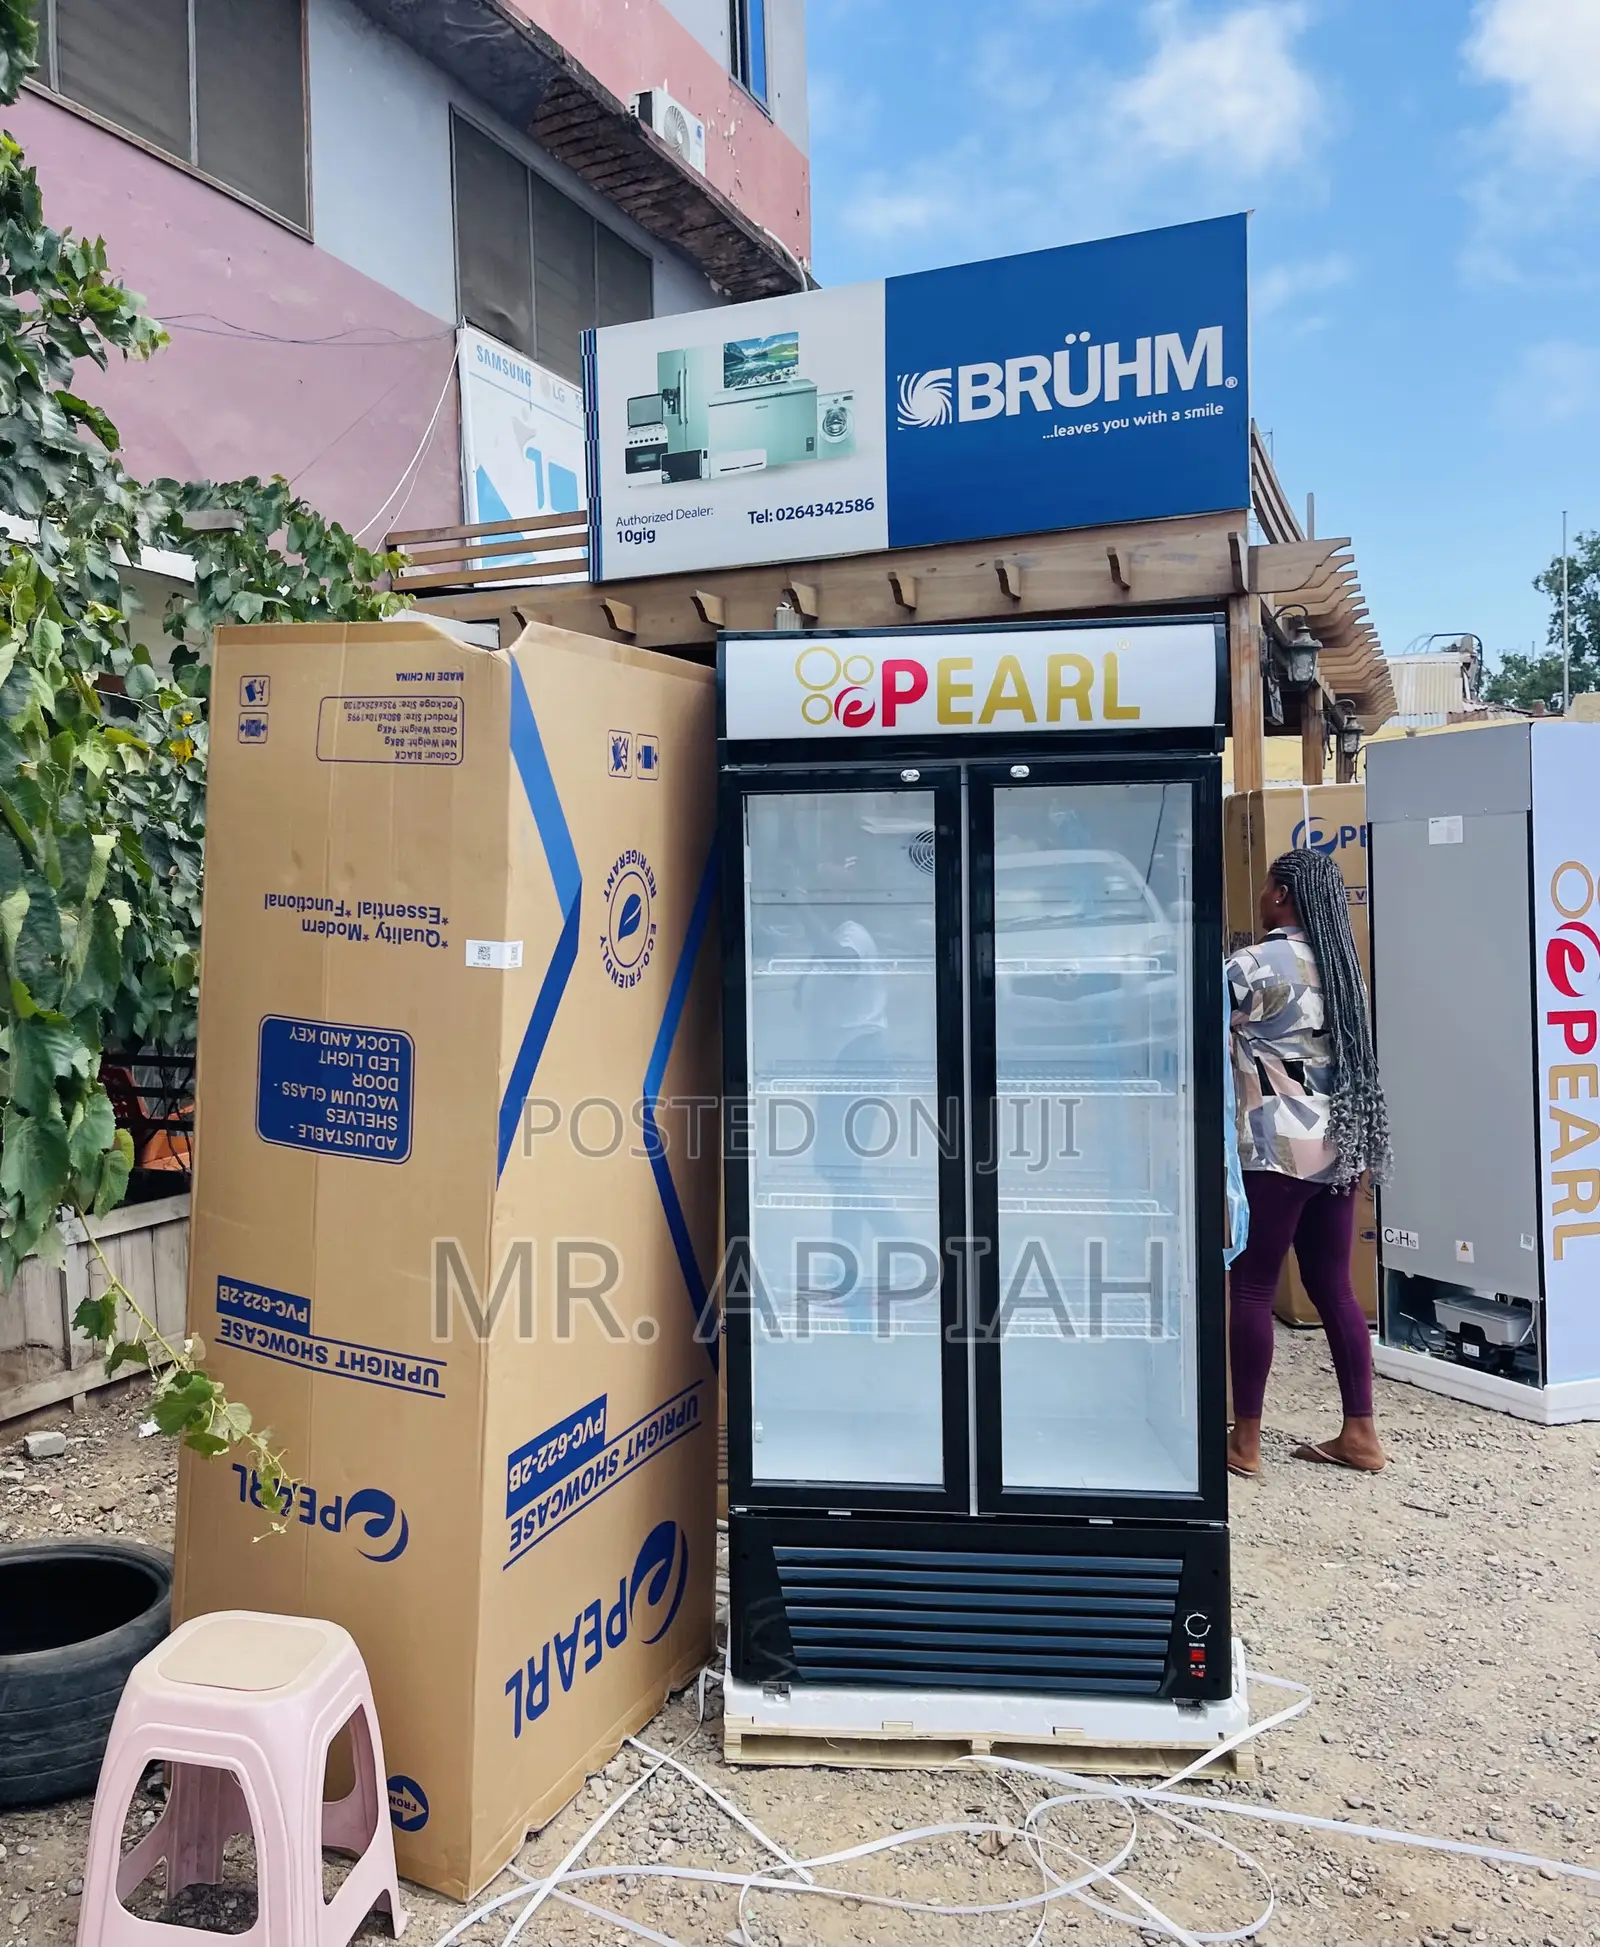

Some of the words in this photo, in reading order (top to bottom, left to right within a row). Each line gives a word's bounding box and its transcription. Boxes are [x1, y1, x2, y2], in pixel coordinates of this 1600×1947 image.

[477, 344, 532, 388] SAMSUNG
[958, 325, 1223, 423] BRÜHM
[1042, 422, 1099, 439] ...leaves
[1102, 416, 1129, 434] you
[1133, 410, 1167, 426] with
[1171, 411, 1181, 421] a
[1184, 403, 1224, 419] smile
[615, 509, 674, 527] Authorized
[676, 506, 714, 521] Dealer:
[747, 509, 773, 524] Tel:
[776, 497, 875, 521] 0264342586
[616, 527, 656, 545] 10gig
[395, 672, 423, 681] CHINA
[425, 672, 435, 681] IN
[437, 672, 464, 681] MADE
[881, 650, 1141, 728] PEARL
[399, 700, 417, 709] Size:
[419, 699, 458, 709] Package
[403, 713, 421, 721] Size:
[423, 713, 458, 722] Product
[377, 723, 397, 734] 94Kg
[399, 724, 430, 735] Weight:
[432, 726, 458, 735] Gross
[407, 737, 439, 748] Weight:
[441, 739, 458, 748] Net
[395, 750, 422, 760] BLACK
[425, 750, 458, 760] Colour:
[604, 849, 657, 902] REFRIGERANT
[600, 923, 657, 988] ECO-FRIENDLY
[289, 1026, 316, 1043] KEY
[319, 1030, 352, 1045] AND
[356, 1033, 400, 1053] LOCK
[319, 1052, 363, 1068] LIGHT
[368, 1055, 400, 1073] LED
[281, 1081, 326, 1101] GLASS
[351, 1072, 399, 1091] DOOR
[331, 1089, 399, 1111] VACUUM
[326, 1108, 398, 1130] SHELVES
[297, 1122, 398, 1150] ADJUSTABLE
[1547, 1009, 1600, 1262] PEARL
[218, 1284, 308, 1324] PVC-622-2B
[220, 1317, 328, 1364] SHOWCASE
[335, 1349, 439, 1388] UPRIGHT
[623, 1395, 699, 1467] UPRIGHT
[508, 1408, 606, 1494] PVC-622-2B
[509, 1448, 620, 1552] SHOWCASE
[505, 1576, 627, 1739] PEARL
